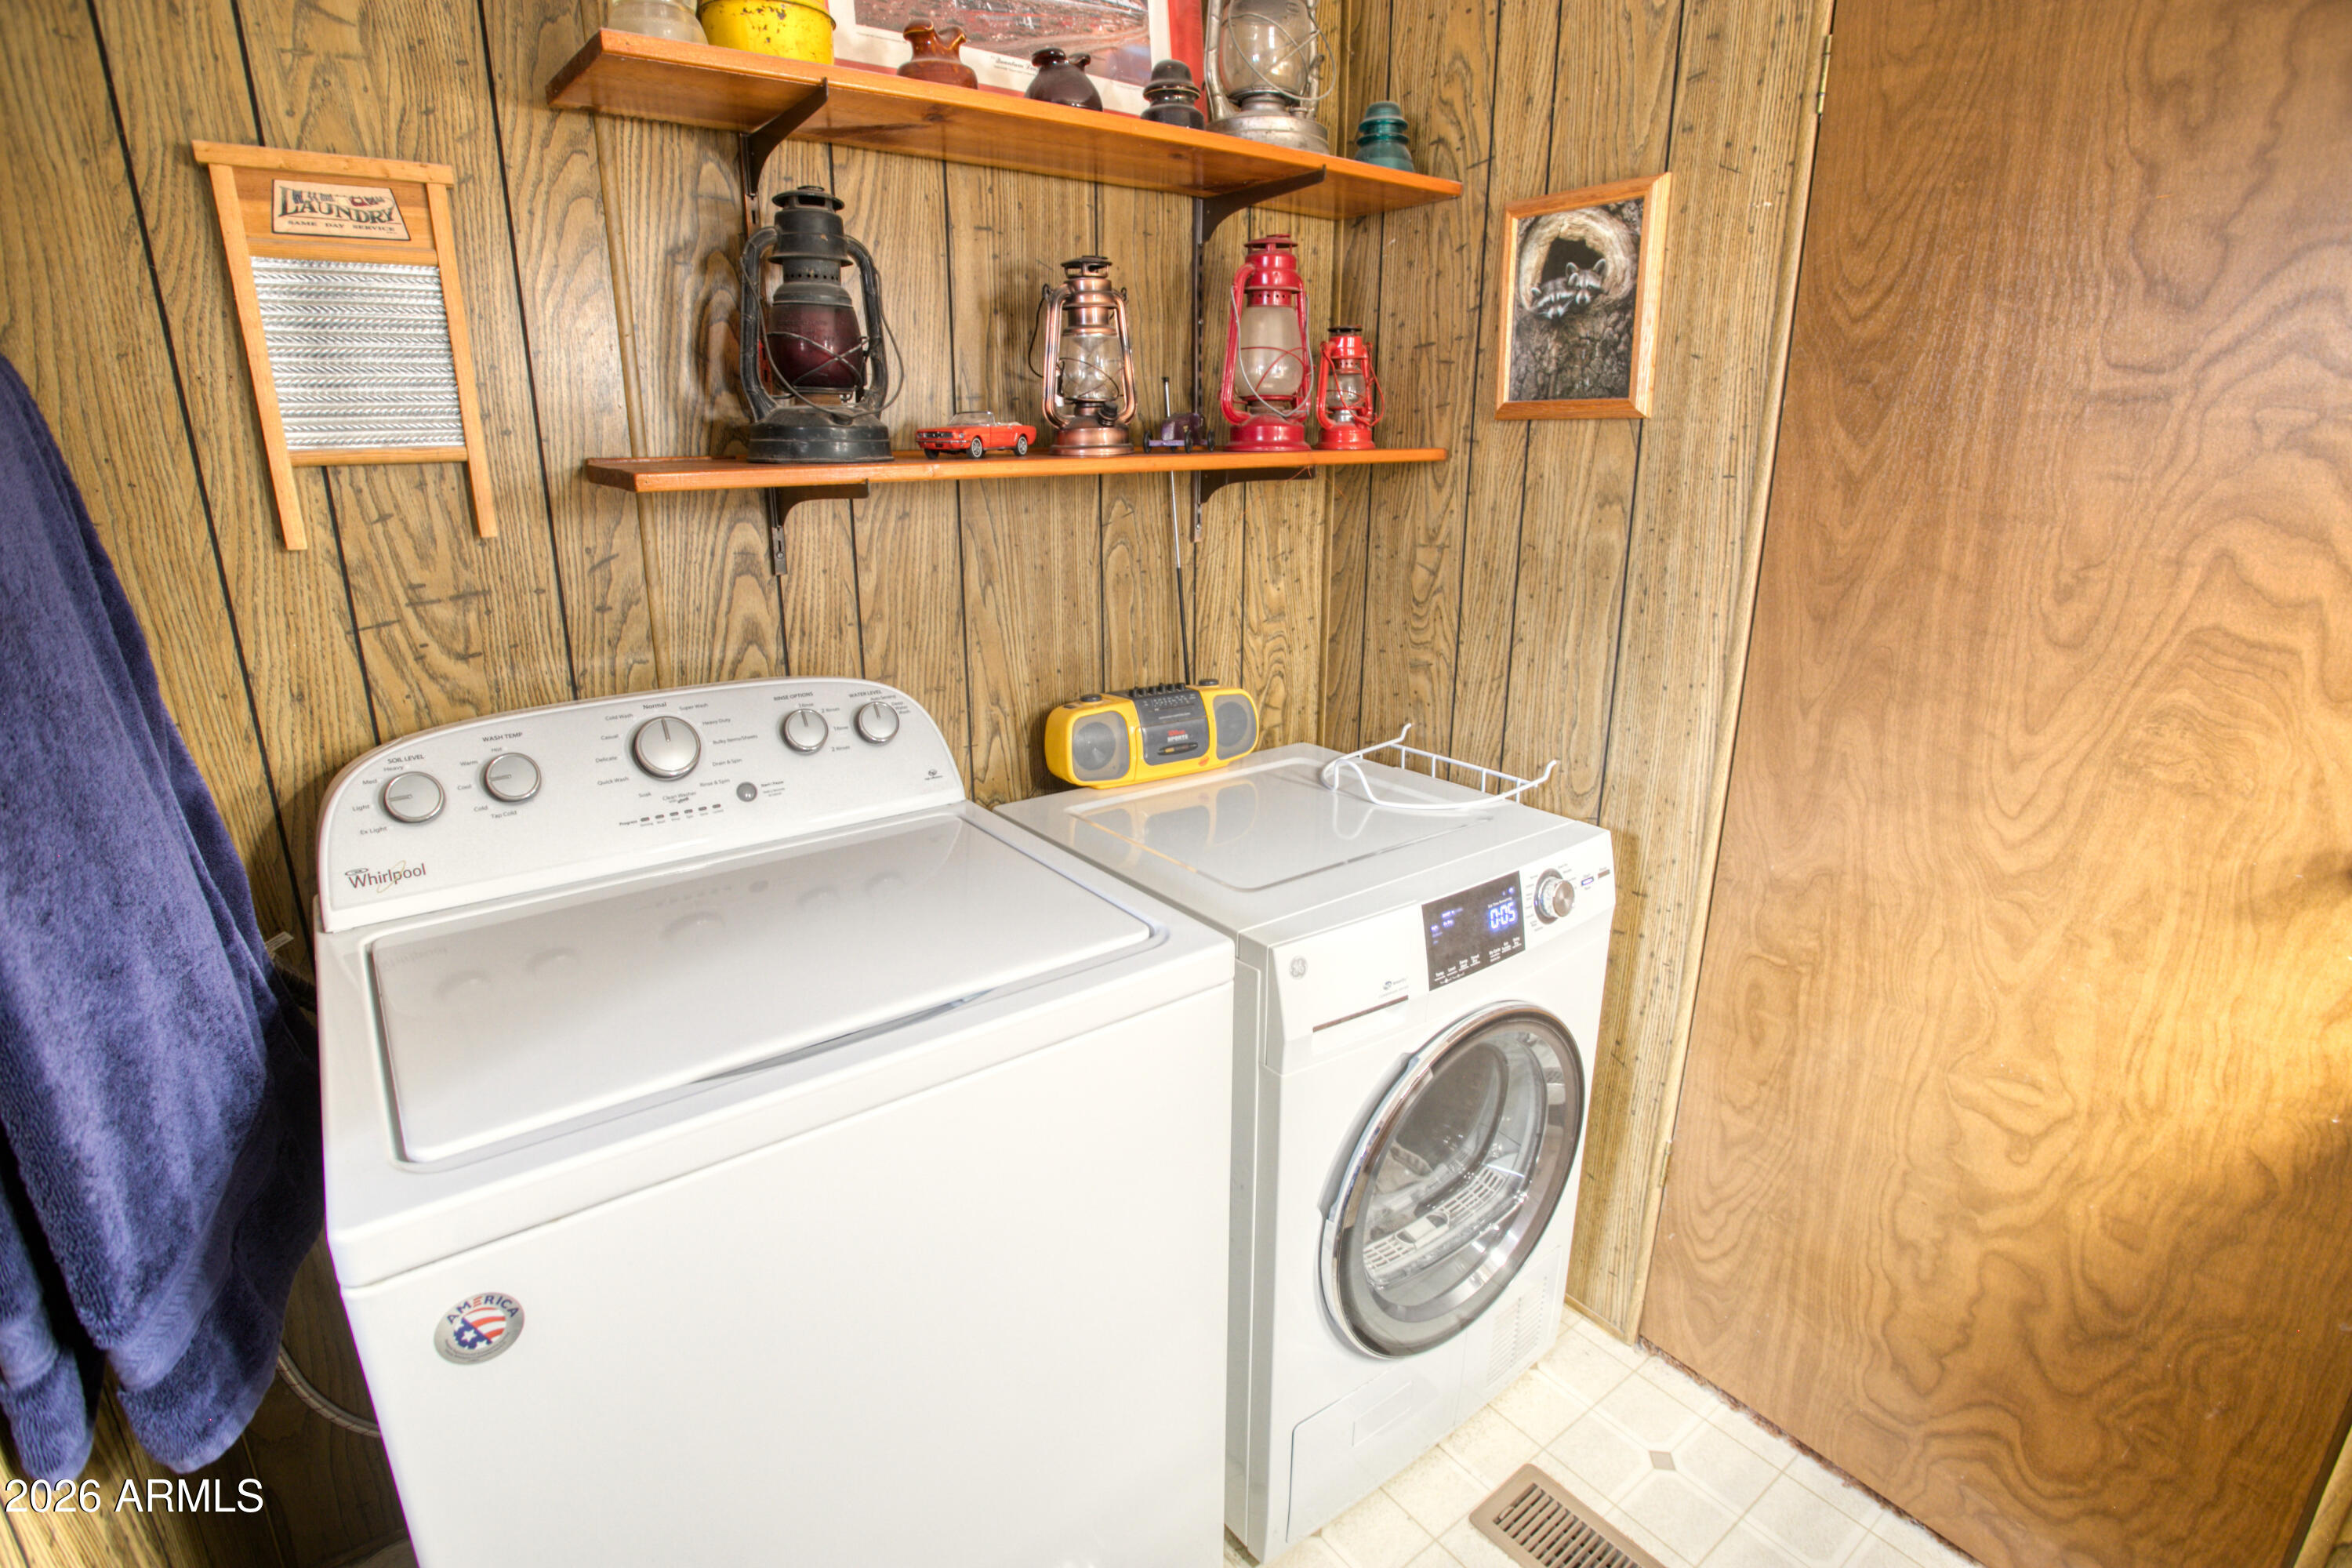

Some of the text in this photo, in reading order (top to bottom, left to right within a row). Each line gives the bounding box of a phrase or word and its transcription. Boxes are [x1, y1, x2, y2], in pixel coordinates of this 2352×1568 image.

[278, 187, 394, 223] LAUNDRY
[353, 804, 370, 812] Light
[370, 826, 387, 834] Light
[348, 862, 426, 889] Whirlpool
[1490, 902, 1515, 929] 0:05
[447, 1295, 519, 1325] AMERICA
